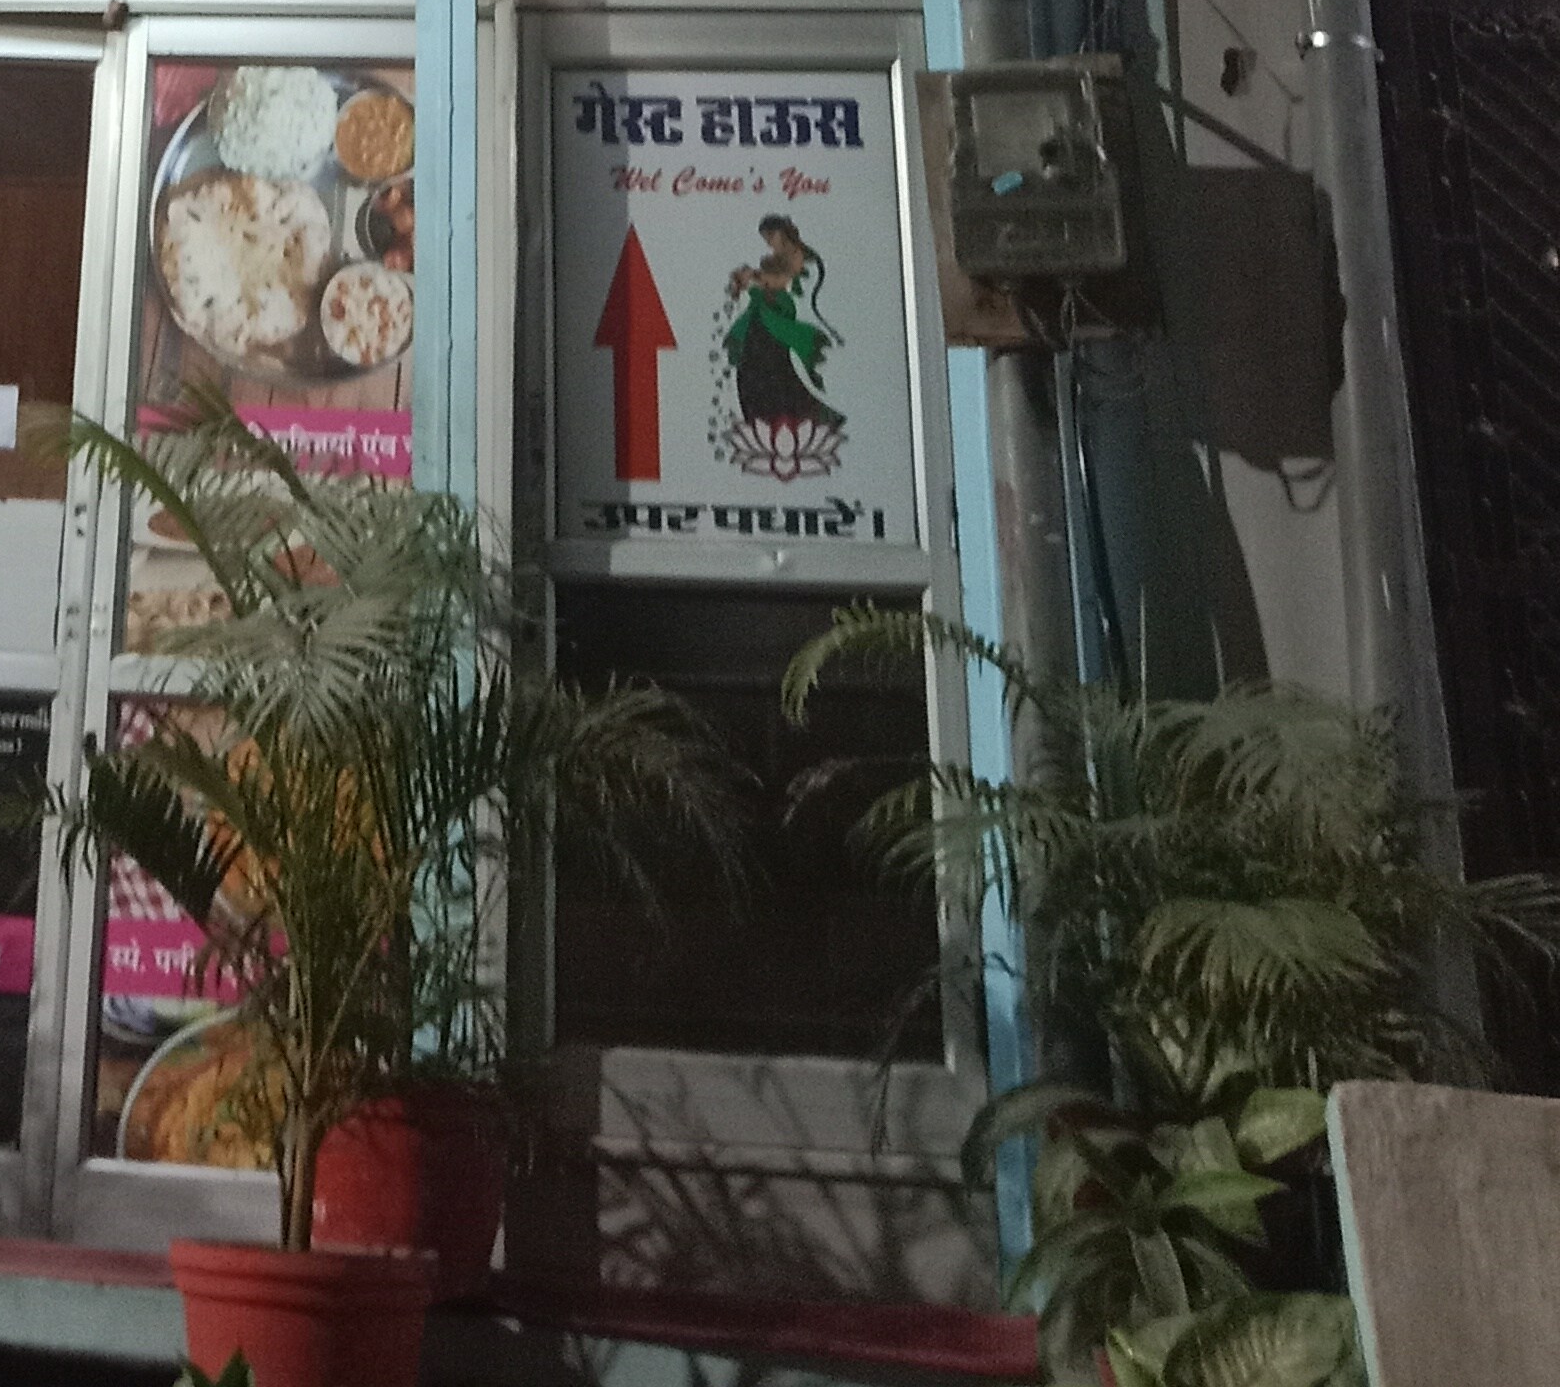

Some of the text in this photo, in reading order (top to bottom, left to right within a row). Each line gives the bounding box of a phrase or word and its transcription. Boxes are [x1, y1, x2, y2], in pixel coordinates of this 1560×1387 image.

[573, 81, 864, 148] गेस्ट हाऊस
[610, 164, 831, 200] Wel Come's You
